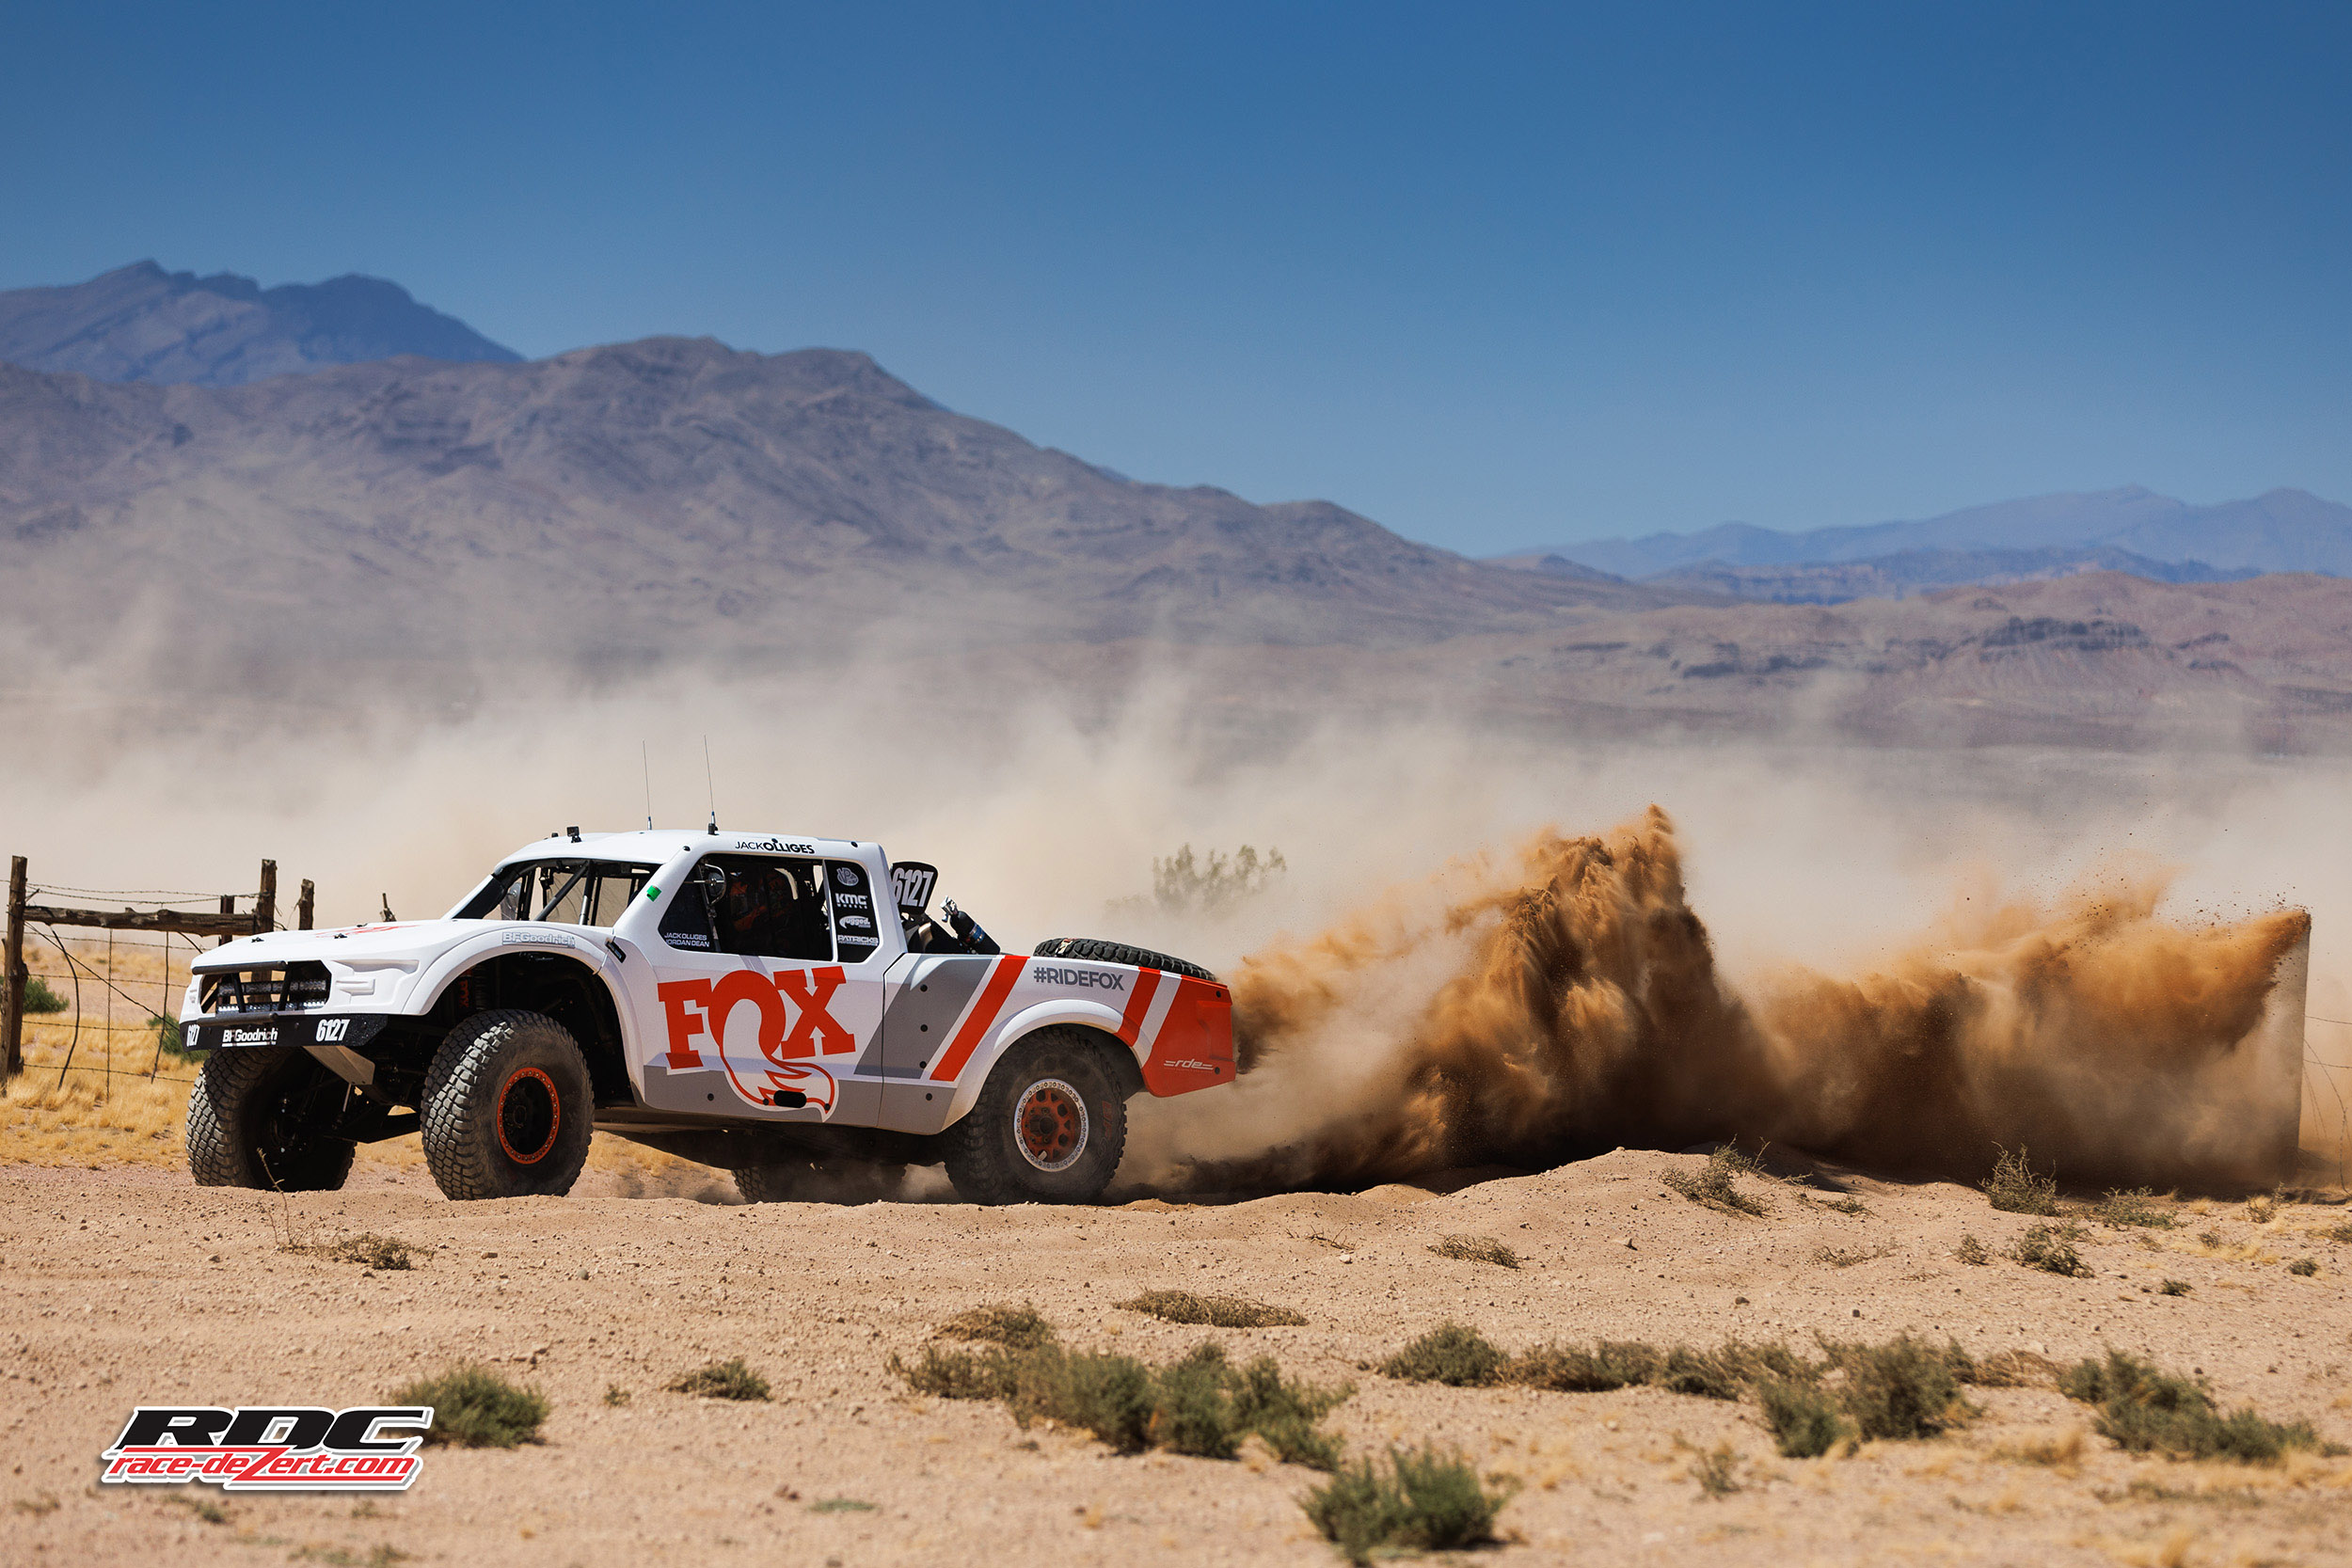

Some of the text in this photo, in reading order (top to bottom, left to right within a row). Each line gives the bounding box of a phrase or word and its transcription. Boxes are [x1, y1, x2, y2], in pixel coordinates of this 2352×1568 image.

[892, 867, 934, 908] 6127
[835, 894, 867, 905] KMC
[502, 932, 575, 946] BFGoodrich
[1033, 967, 1125, 991] #RIDEFOX
[222, 1027, 278, 1044] BFGoodrich
[315, 1019, 351, 1042] 6127
[657, 966, 856, 1114] FOX
